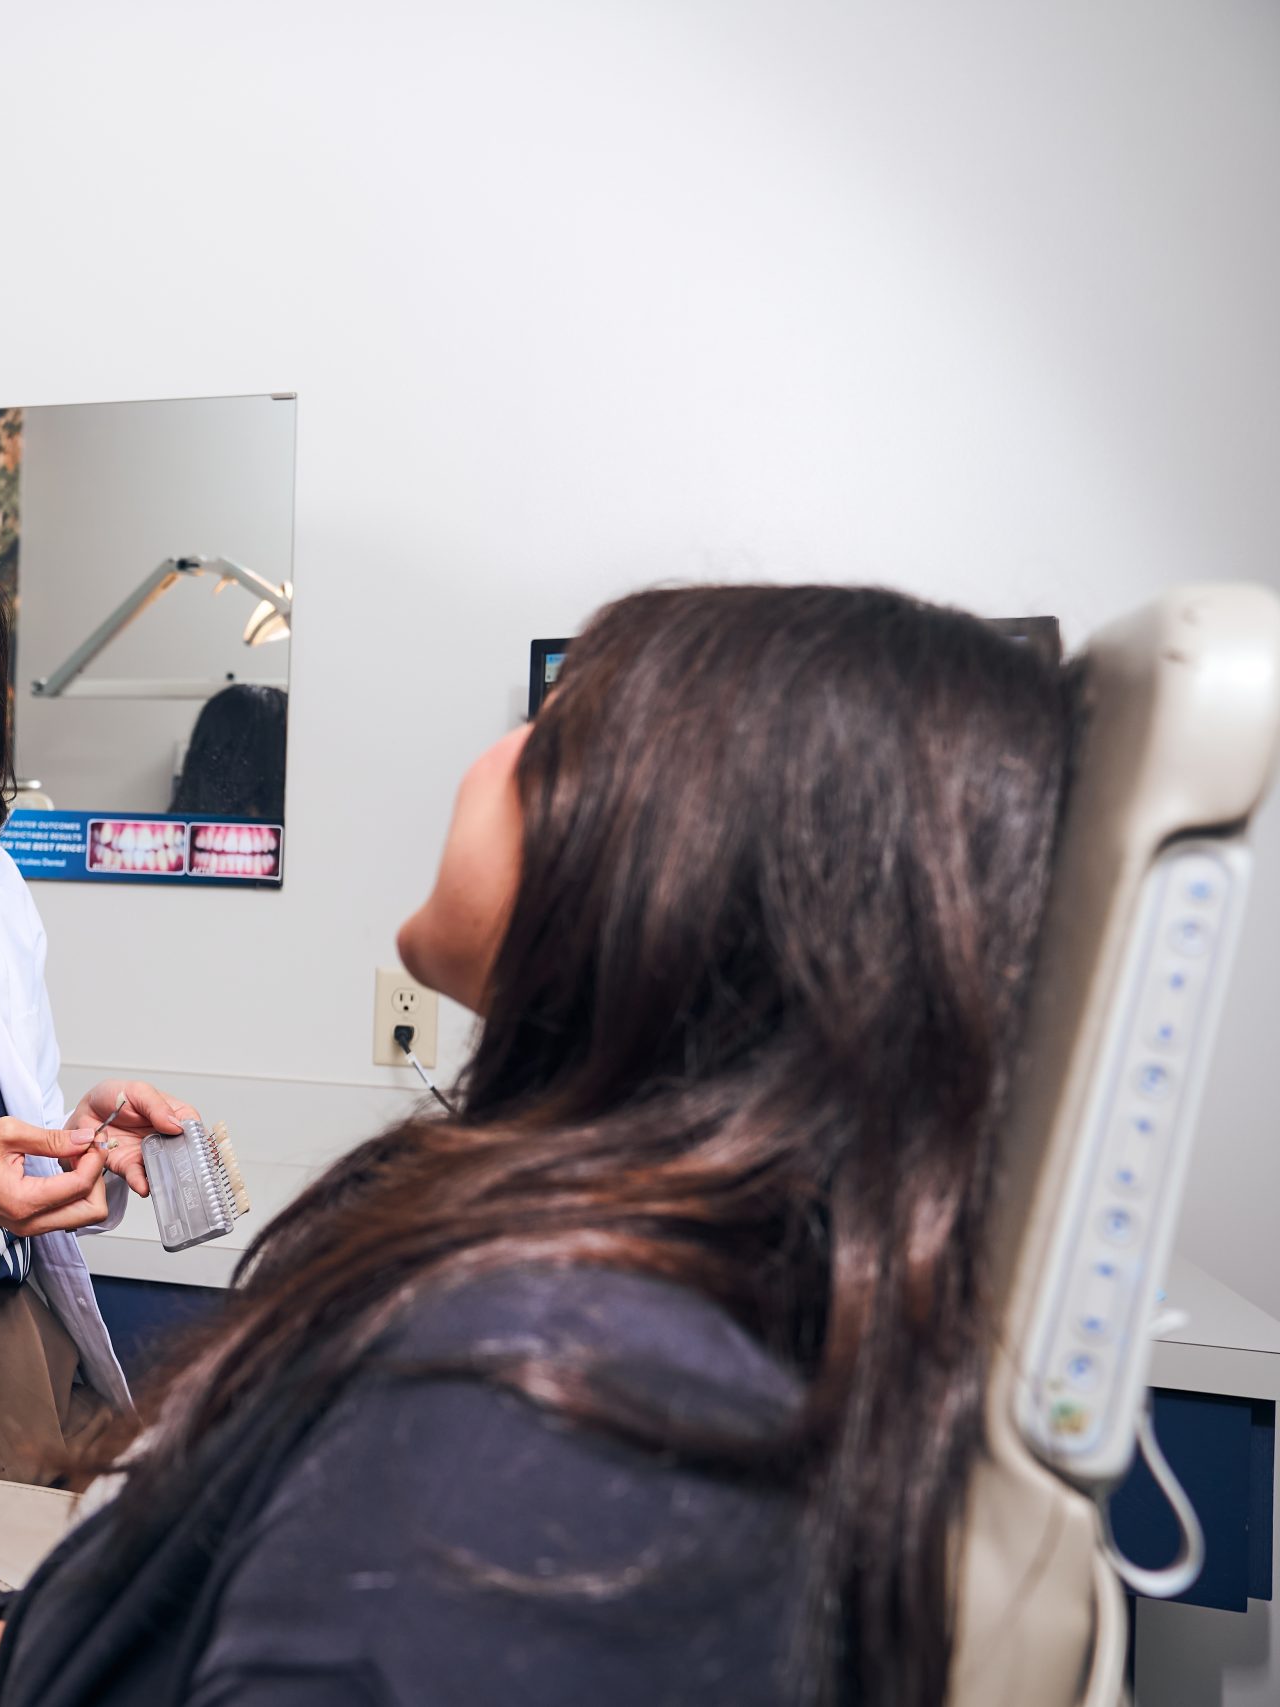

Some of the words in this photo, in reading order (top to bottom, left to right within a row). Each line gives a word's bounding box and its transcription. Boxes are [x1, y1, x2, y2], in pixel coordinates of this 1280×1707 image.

[37, 821, 81, 831] OUTCOMES
[49, 832, 82, 841] RESULTS
[14, 841, 32, 851] THE
[32, 842, 55, 852] BEST
